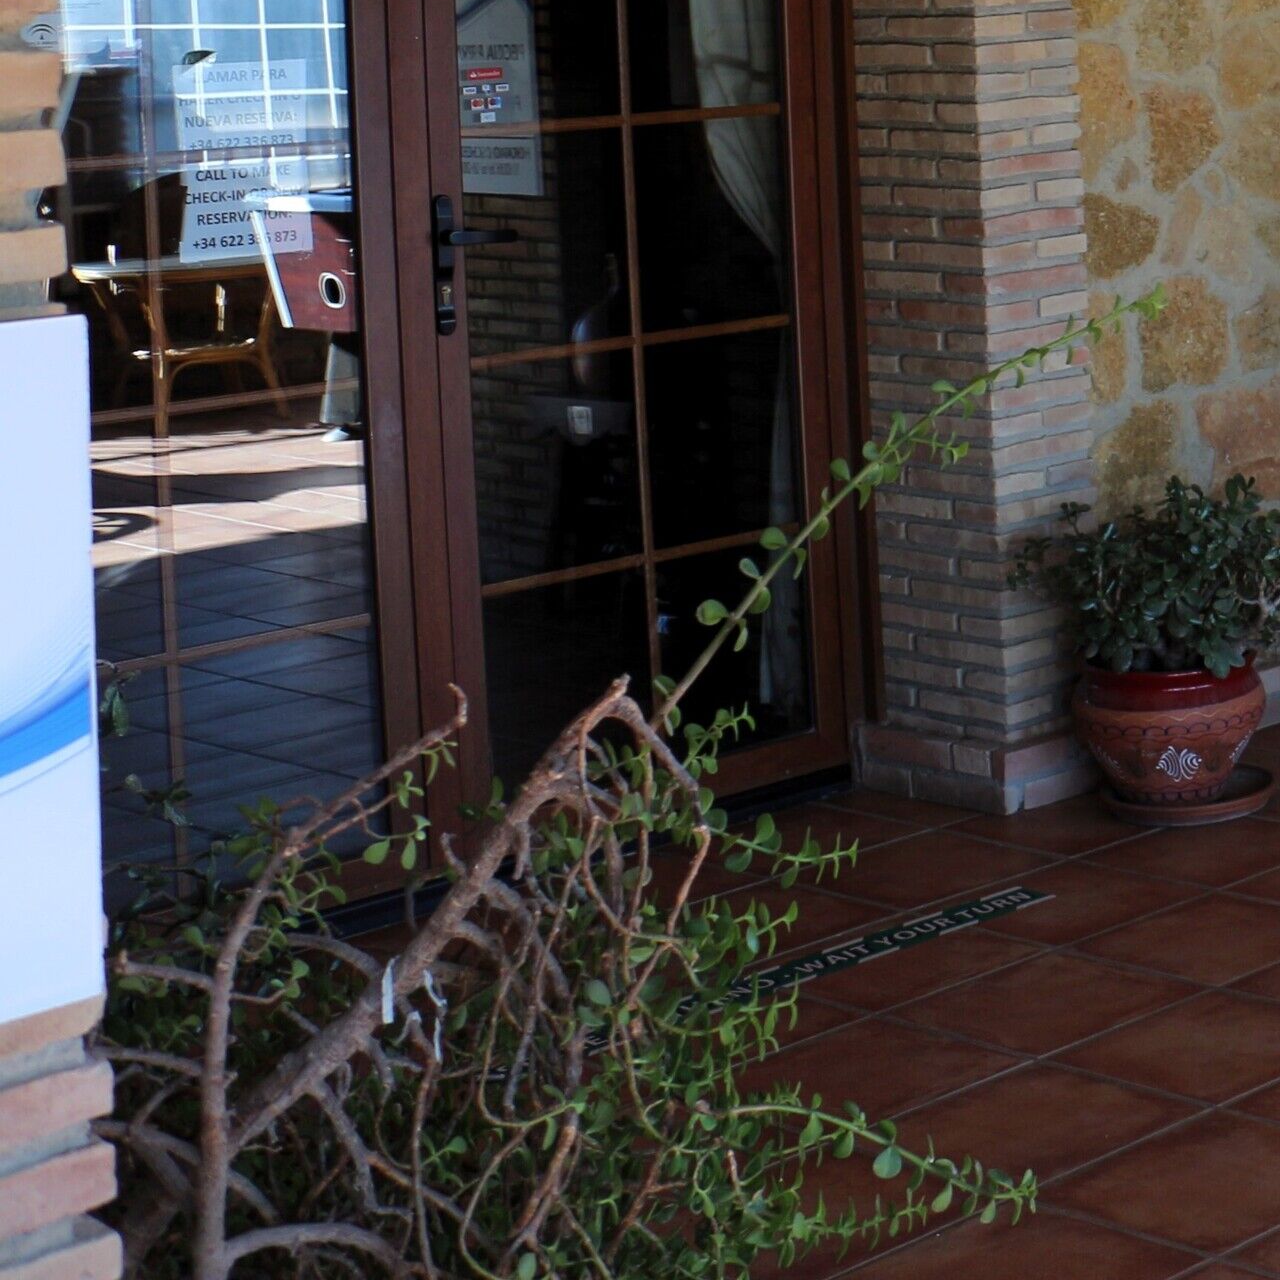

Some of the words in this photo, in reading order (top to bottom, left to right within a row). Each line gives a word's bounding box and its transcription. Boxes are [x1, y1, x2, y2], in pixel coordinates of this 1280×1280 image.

[185, 114, 231, 128] NUEVA
[195, 169, 226, 182] CALL
[229, 167, 248, 180] TO
[184, 188, 245, 205] CHECK-IN
[192, 236, 216, 250] +34
[220, 235, 244, 248] 622
[274, 229, 298, 243] 873
[795, 943, 869, 974] WAIT
[873, 917, 956, 946] YOUR
[954, 891, 1031, 920] TURN
